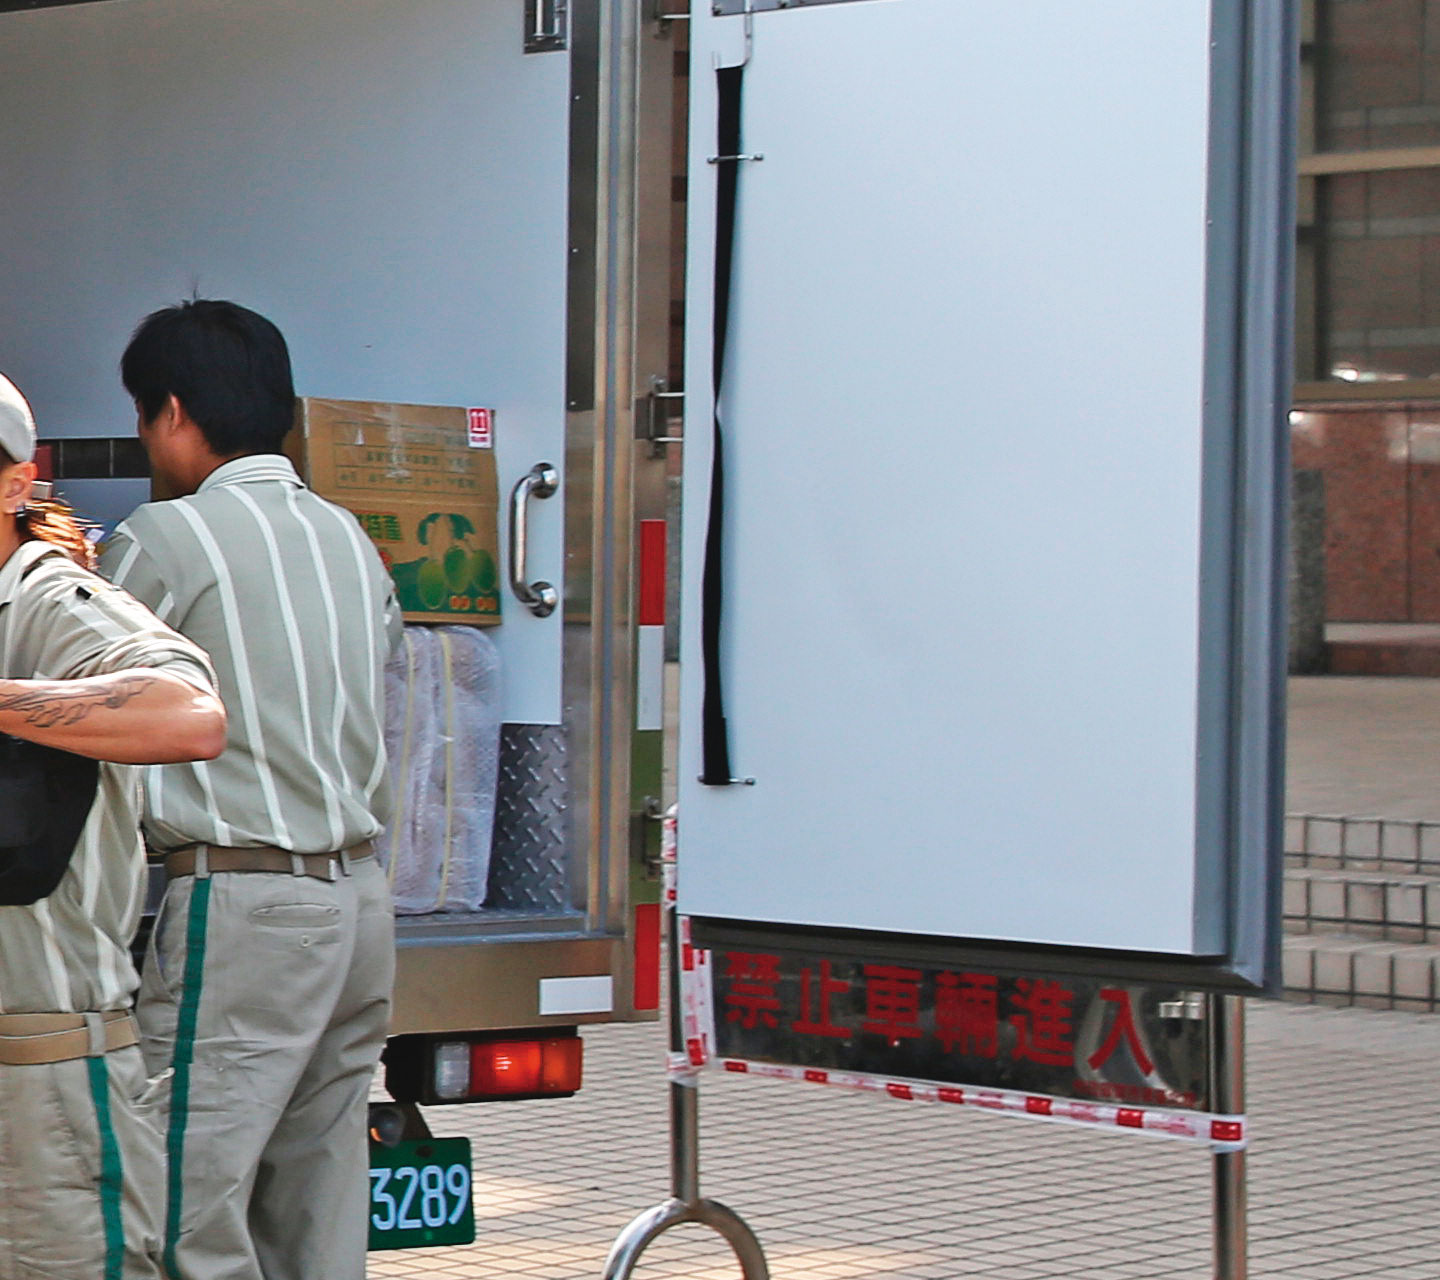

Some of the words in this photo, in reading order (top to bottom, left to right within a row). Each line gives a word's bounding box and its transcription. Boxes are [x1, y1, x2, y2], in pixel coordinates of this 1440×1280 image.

[724, 949, 1156, 1078] 禁止車輛進入
[368, 1163, 471, 1231] 3289
